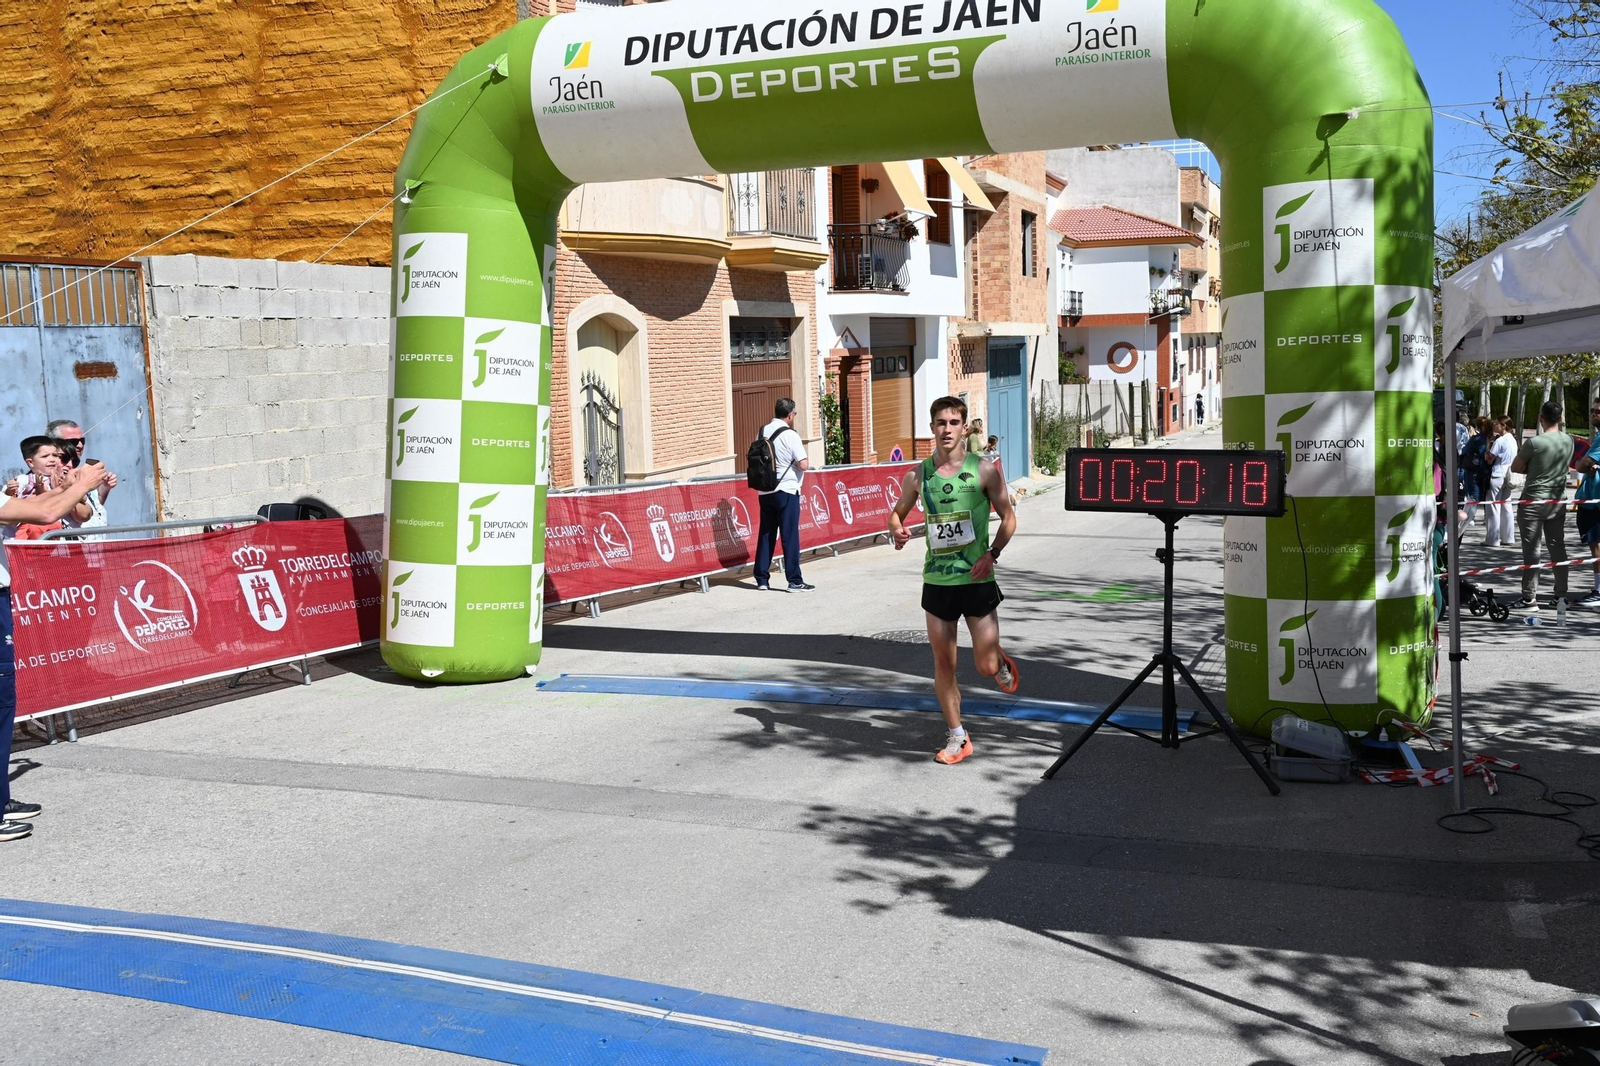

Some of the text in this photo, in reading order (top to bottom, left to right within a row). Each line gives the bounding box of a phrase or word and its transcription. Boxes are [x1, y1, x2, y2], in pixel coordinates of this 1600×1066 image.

[624, 9, 858, 66] DIPUTACIÓN
[869, 3, 924, 40] DE
[1066, 18, 1137, 54] Jaén
[1055, 48, 1151, 67] PARAÍSO INTERIOR
[690, 45, 961, 103] DEPORTES
[548, 73, 603, 104] Jaén
[542, 100, 615, 115] PARAÍSO INTERIOR
[1293, 226, 1364, 240] DIPUTACIÓN
[1294, 240, 1341, 253] DE JAÉN
[411, 270, 458, 279] DIPUTACIÓN
[480, 273, 534, 286] www.dipujaen.es
[421, 279, 441, 289] JAÉN
[1277, 334, 1362, 347] DEPORTES
[1403, 346, 1412, 356] DE
[400, 353, 453, 362] DEPORTES
[489, 356, 535, 368] DIPUTACIÓN
[489, 366, 521, 376] DE JAÉN
[406, 435, 452, 445] DIPUTACIÓN
[472, 438, 530, 448] DEPORTES
[1295, 438, 1365, 450] DIPUTACIÓN
[1388, 438, 1433, 448] DEPORTES
[406, 444, 434, 454] DE JAÉN
[1295, 451, 1342, 462] DE JAÉN
[1080, 458, 1267, 506] 00:20:18
[669, 508, 722, 523] TORREDELCAMPO
[396, 518, 444, 527] www.dipujaen.es
[484, 520, 529, 529] DIPUTACIÓN
[484, 529, 515, 539] DE JAÉN
[936, 522, 963, 540] 234
[1281, 543, 1359, 556] www.dipujaen.es
[278, 549, 384, 574] TORREDELCAMPO
[299, 600, 350, 617] CONCEJALÍA
[350, 599, 361, 609] DE
[400, 598, 447, 610] DIPUTACIÓN
[466, 602, 525, 611] DEPORTES
[400, 608, 430, 618] DE JAÉN
[135, 618, 190, 637] DEPORTES
[138, 629, 193, 645] TORREDELCAMPO
[29, 654, 48, 668] DE
[50, 642, 117, 664] DEPORTES
[1298, 646, 1367, 658] DIPUTACIÓN
[1298, 658, 1345, 670] DE JAÉN
